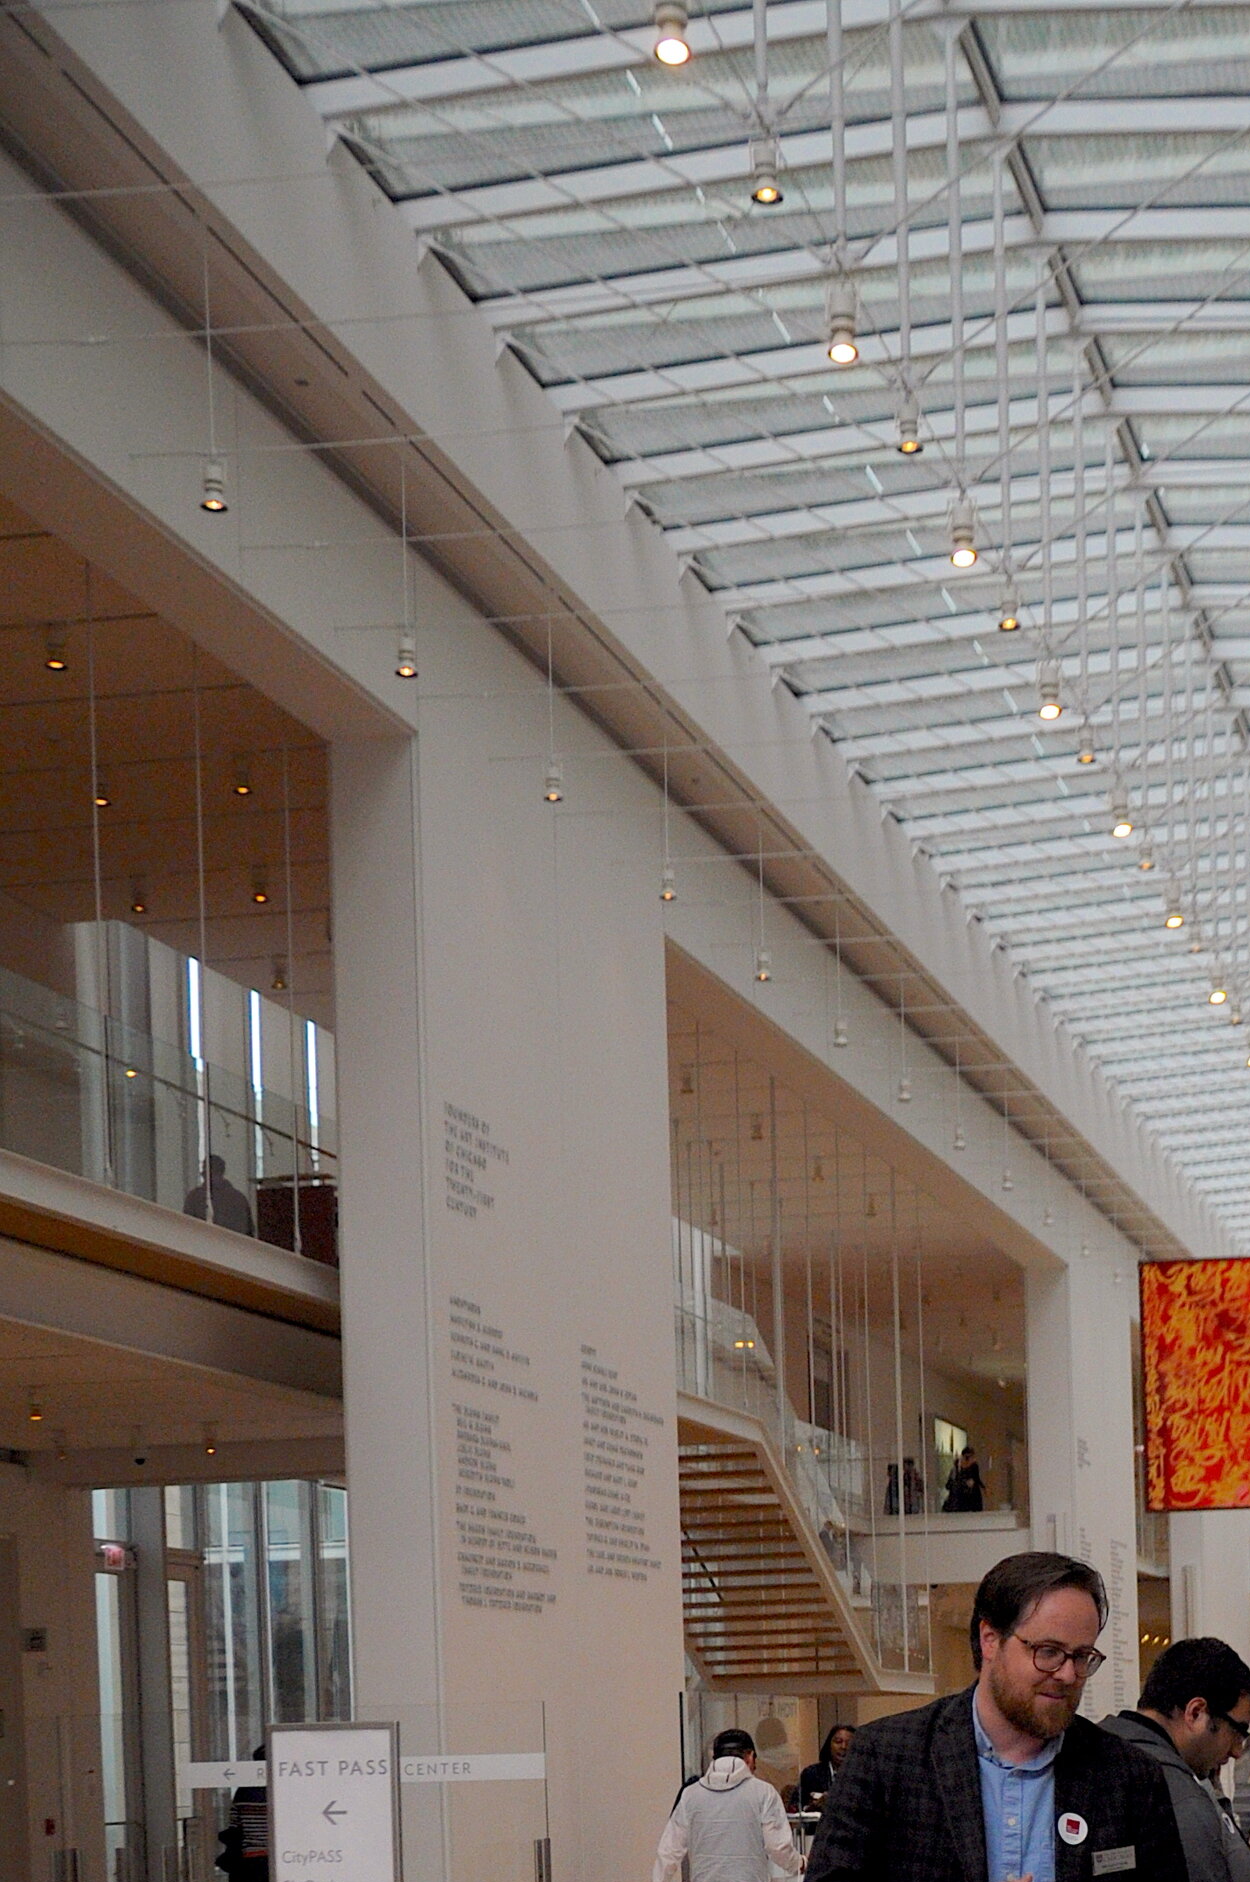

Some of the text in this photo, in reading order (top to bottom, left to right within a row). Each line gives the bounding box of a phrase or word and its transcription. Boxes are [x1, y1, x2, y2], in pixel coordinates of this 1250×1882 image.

[278, 1760, 328, 1777] FAST
[338, 1759, 388, 1776] PASS
[404, 1762, 471, 1776] CENTER
[282, 1850, 343, 1866] CityPASS
